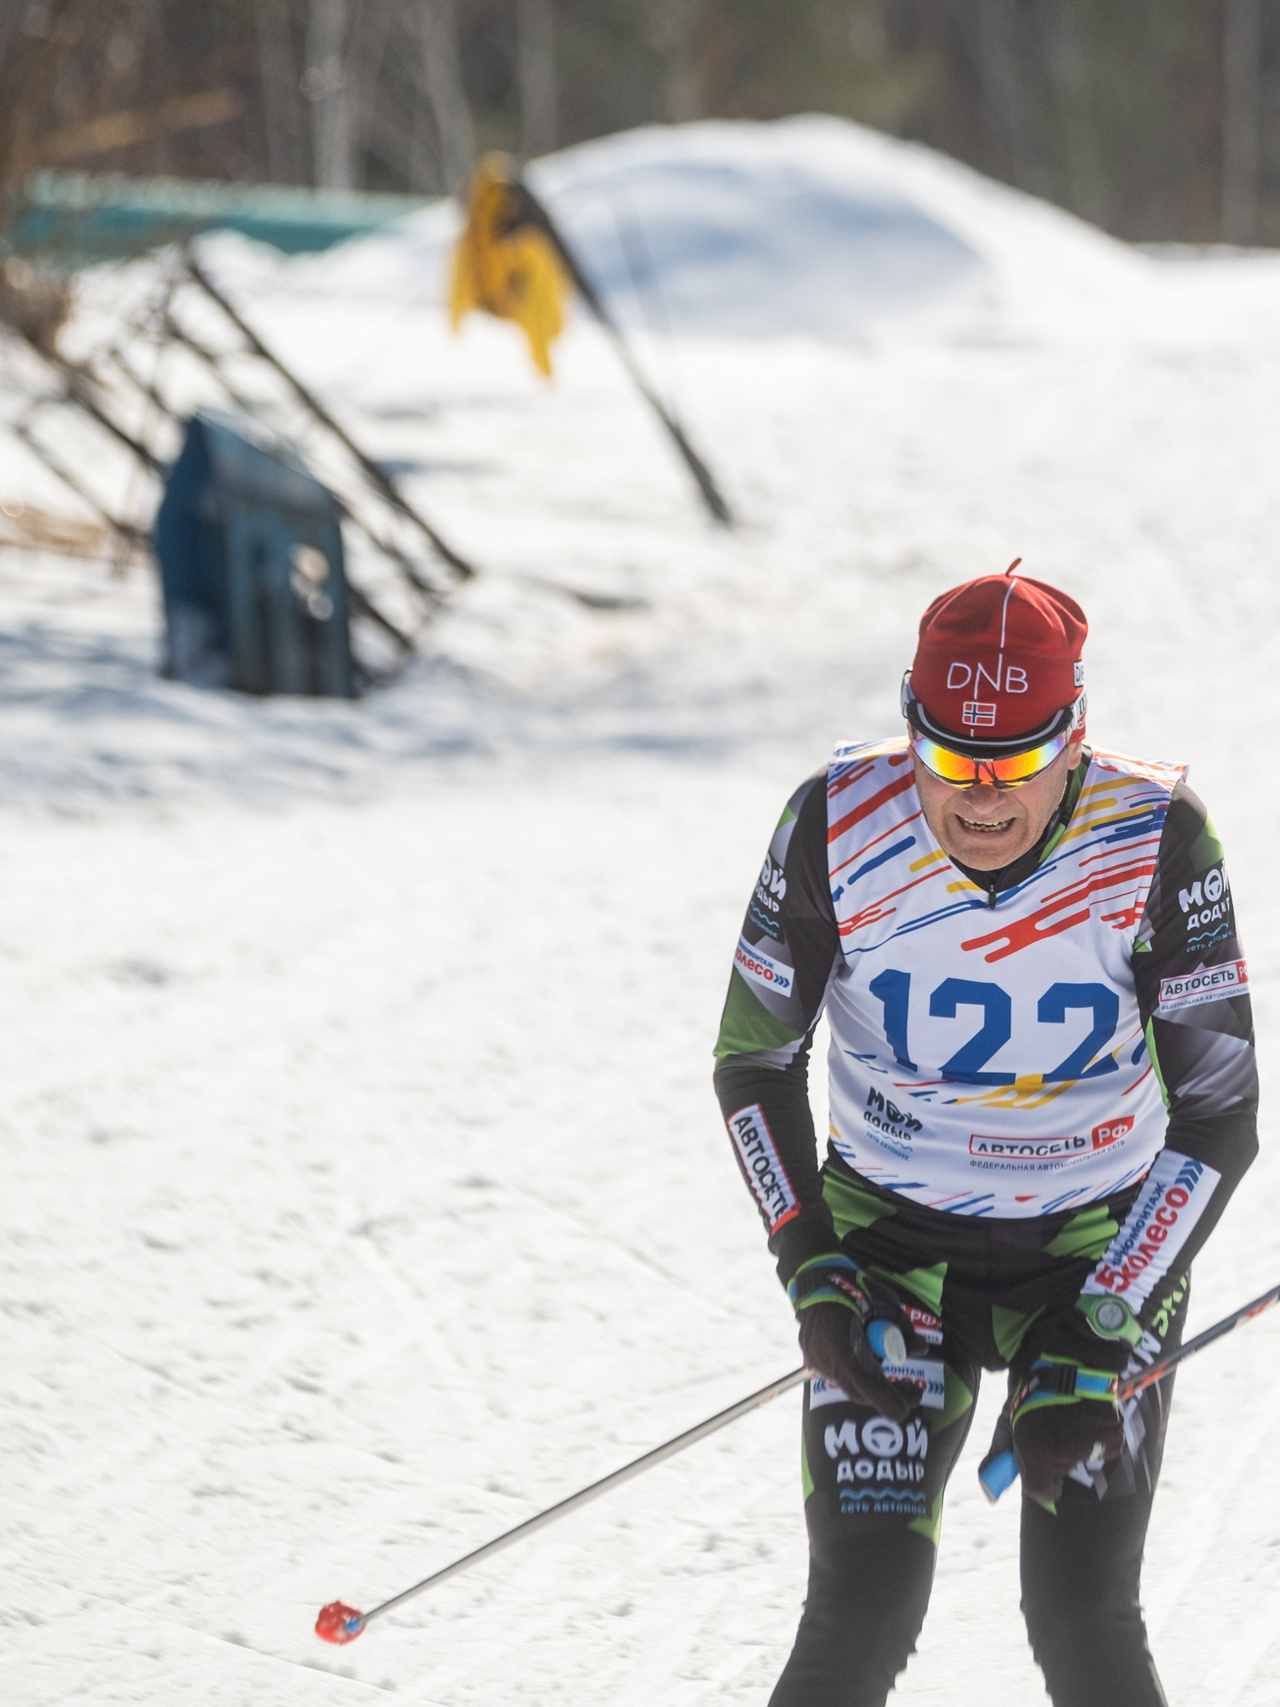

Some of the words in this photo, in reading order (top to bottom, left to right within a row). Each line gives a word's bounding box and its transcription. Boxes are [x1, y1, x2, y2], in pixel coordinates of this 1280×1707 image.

[947, 656, 1029, 698] DNB
[761, 852, 787, 901] ОЙ
[1164, 970, 1235, 996] АВТОСЕТЬ
[869, 968, 1120, 1087] 122
[867, 1086, 923, 1132] МОЙ
[1098, 1124, 1128, 1143] РФ
[970, 1160, 1035, 1171] ФЕДЕРАЛЬНАЯ
[1108, 1140, 1126, 1151] СЕТЬ
[824, 1416, 928, 1460] МОЙ
[837, 1459, 925, 1483] ДОДЫР
